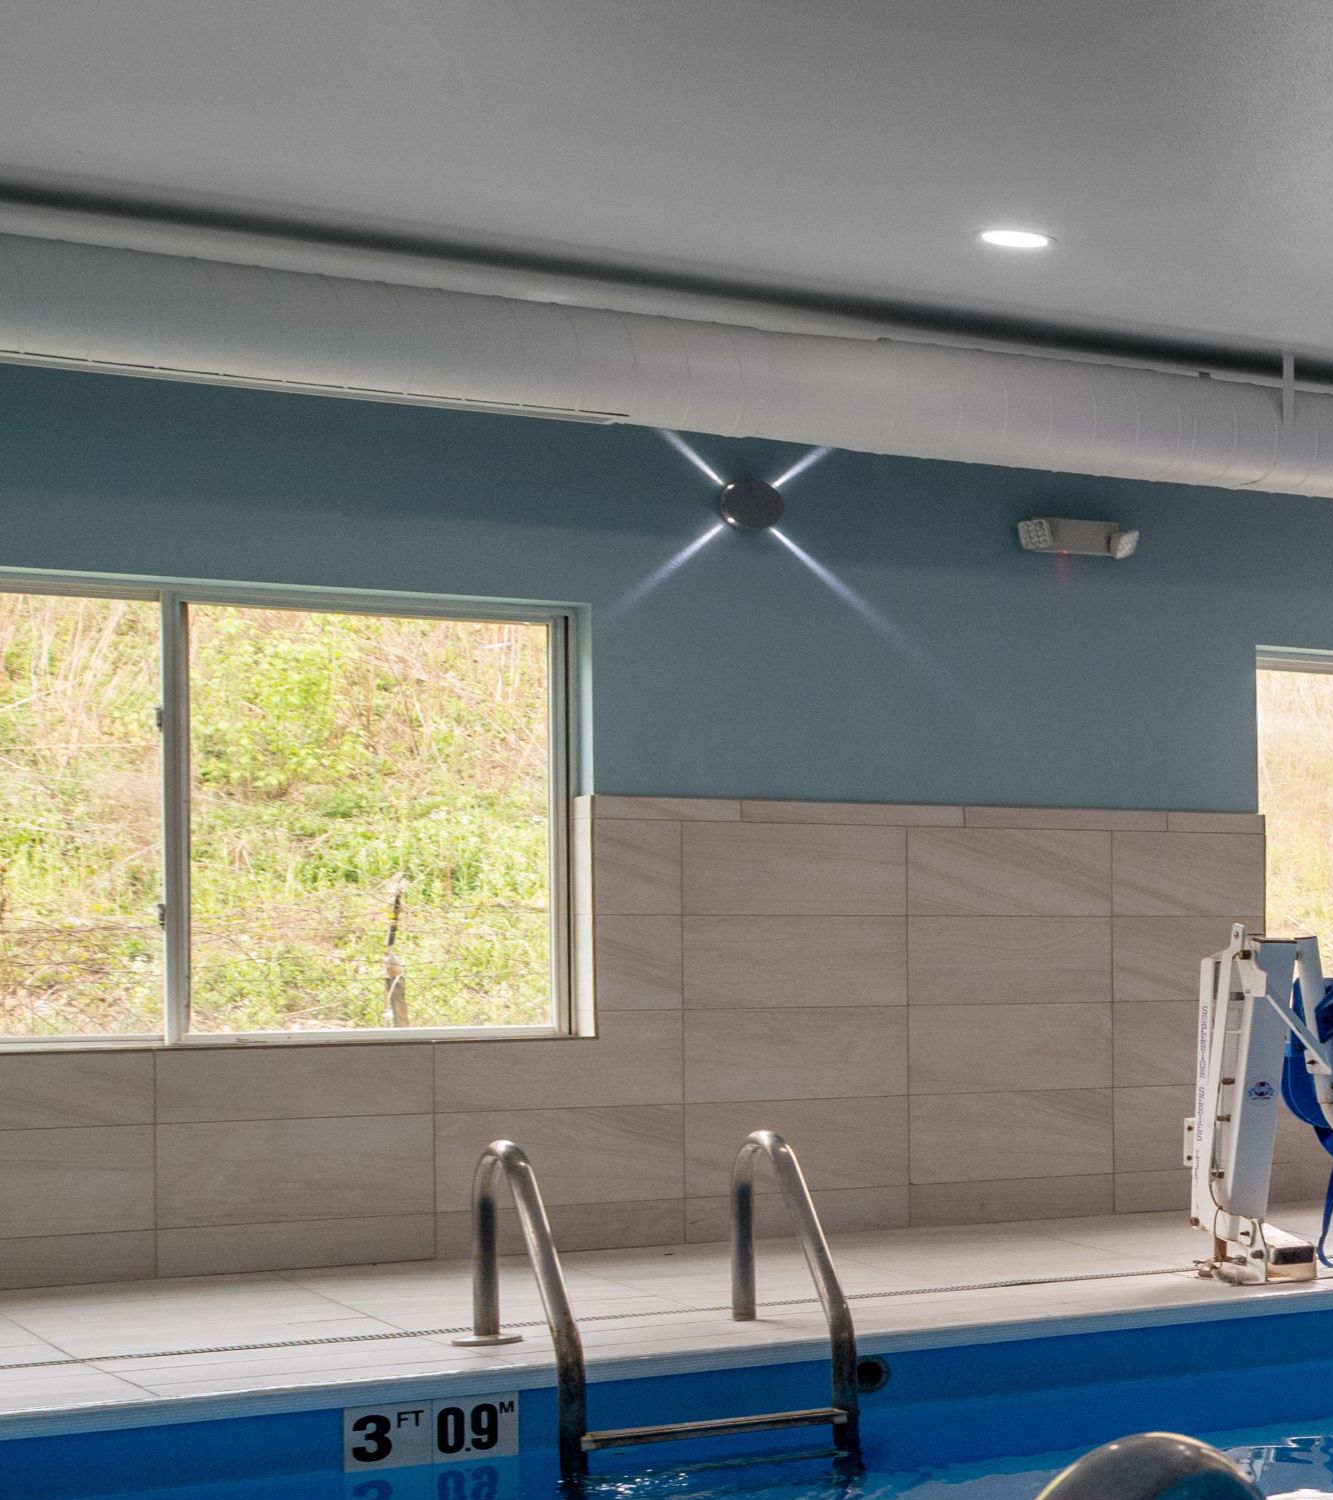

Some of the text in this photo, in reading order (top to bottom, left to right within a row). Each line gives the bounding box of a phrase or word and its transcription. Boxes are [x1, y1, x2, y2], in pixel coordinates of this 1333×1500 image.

[352, 1414, 393, 1463] 3
[397, 1410, 425, 1428] FT
[437, 1403, 499, 1455] 0.9
